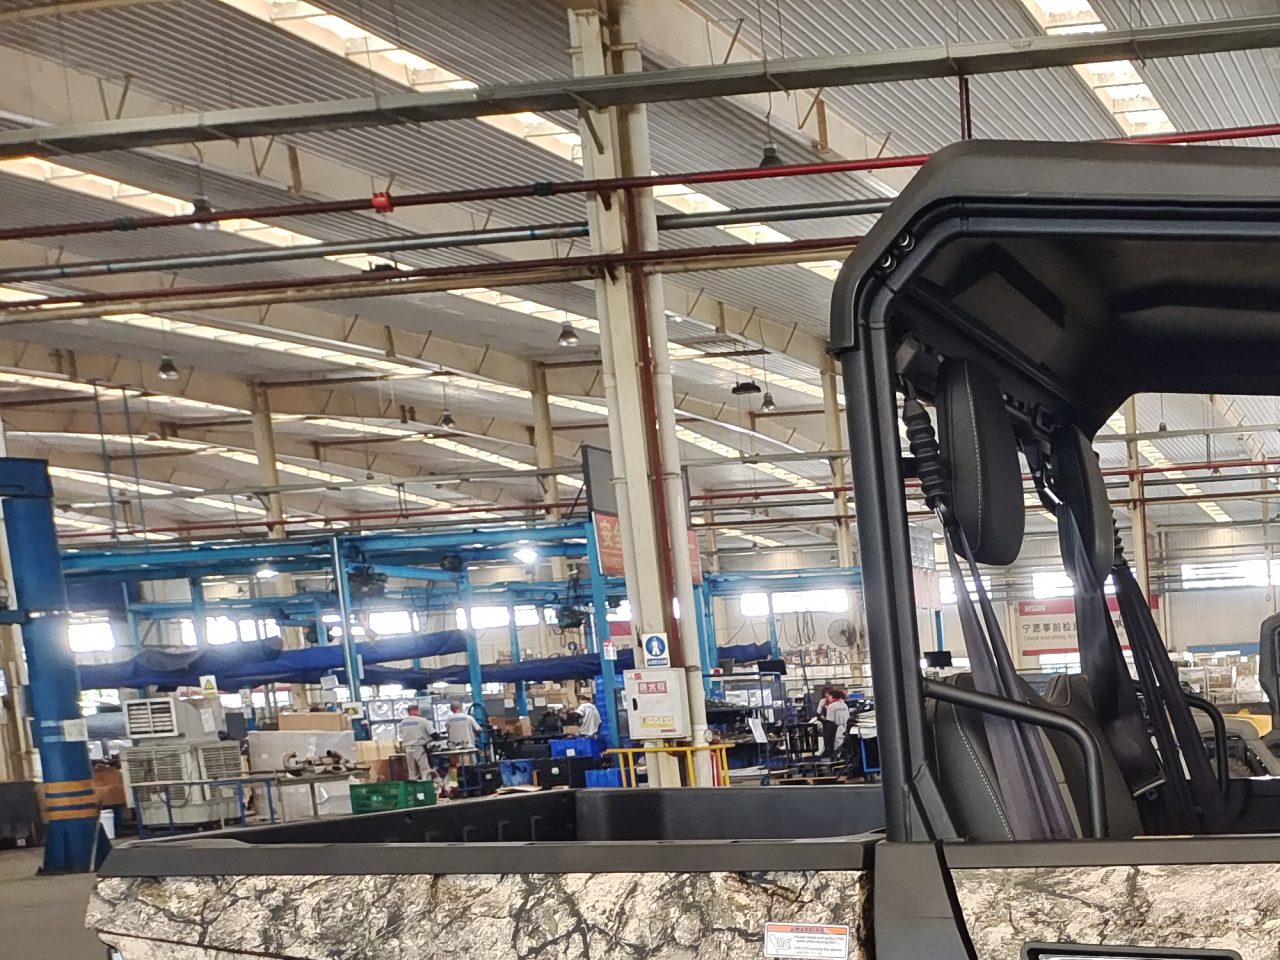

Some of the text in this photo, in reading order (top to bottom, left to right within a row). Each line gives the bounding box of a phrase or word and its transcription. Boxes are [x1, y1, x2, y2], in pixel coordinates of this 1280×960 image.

[1023, 622, 1076, 633] 宁愿事前检
